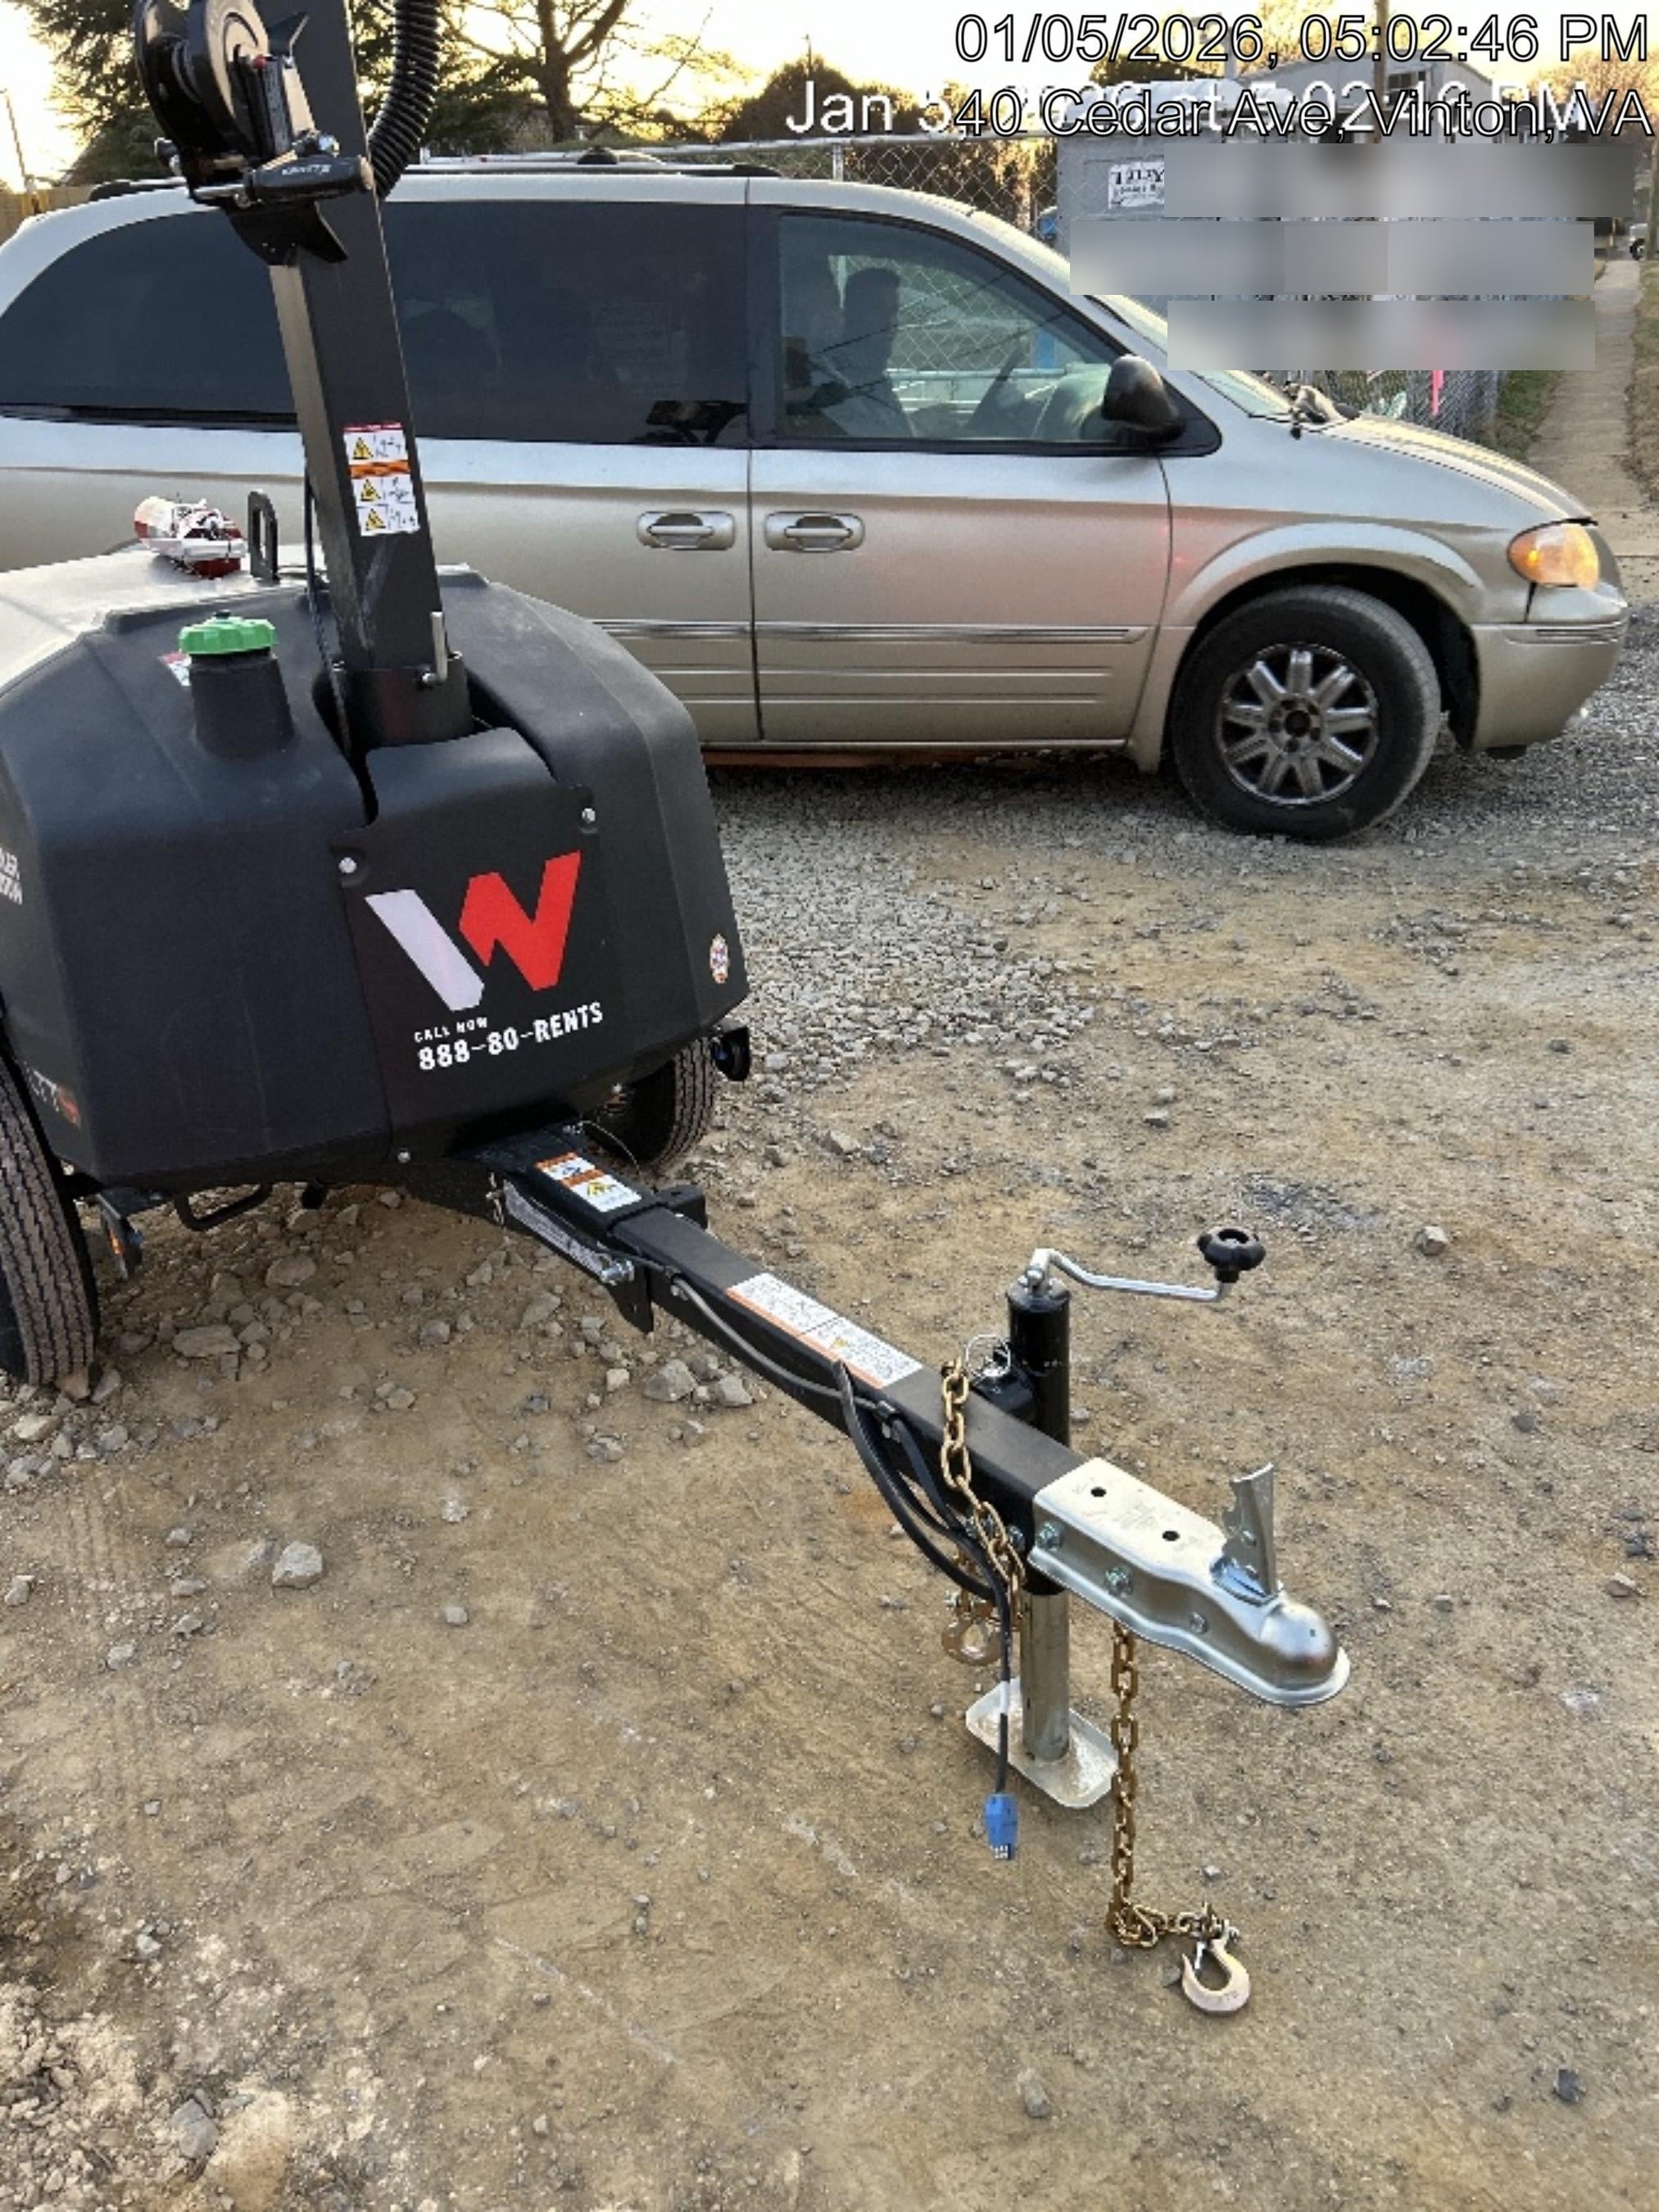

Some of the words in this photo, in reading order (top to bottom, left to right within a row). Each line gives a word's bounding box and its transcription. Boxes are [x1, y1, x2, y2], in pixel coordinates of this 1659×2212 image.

[414, 1026, 451, 1043] CALL
[456, 1016, 488, 1034] NOW
[417, 1000, 604, 1071] 888-80-RENTS
